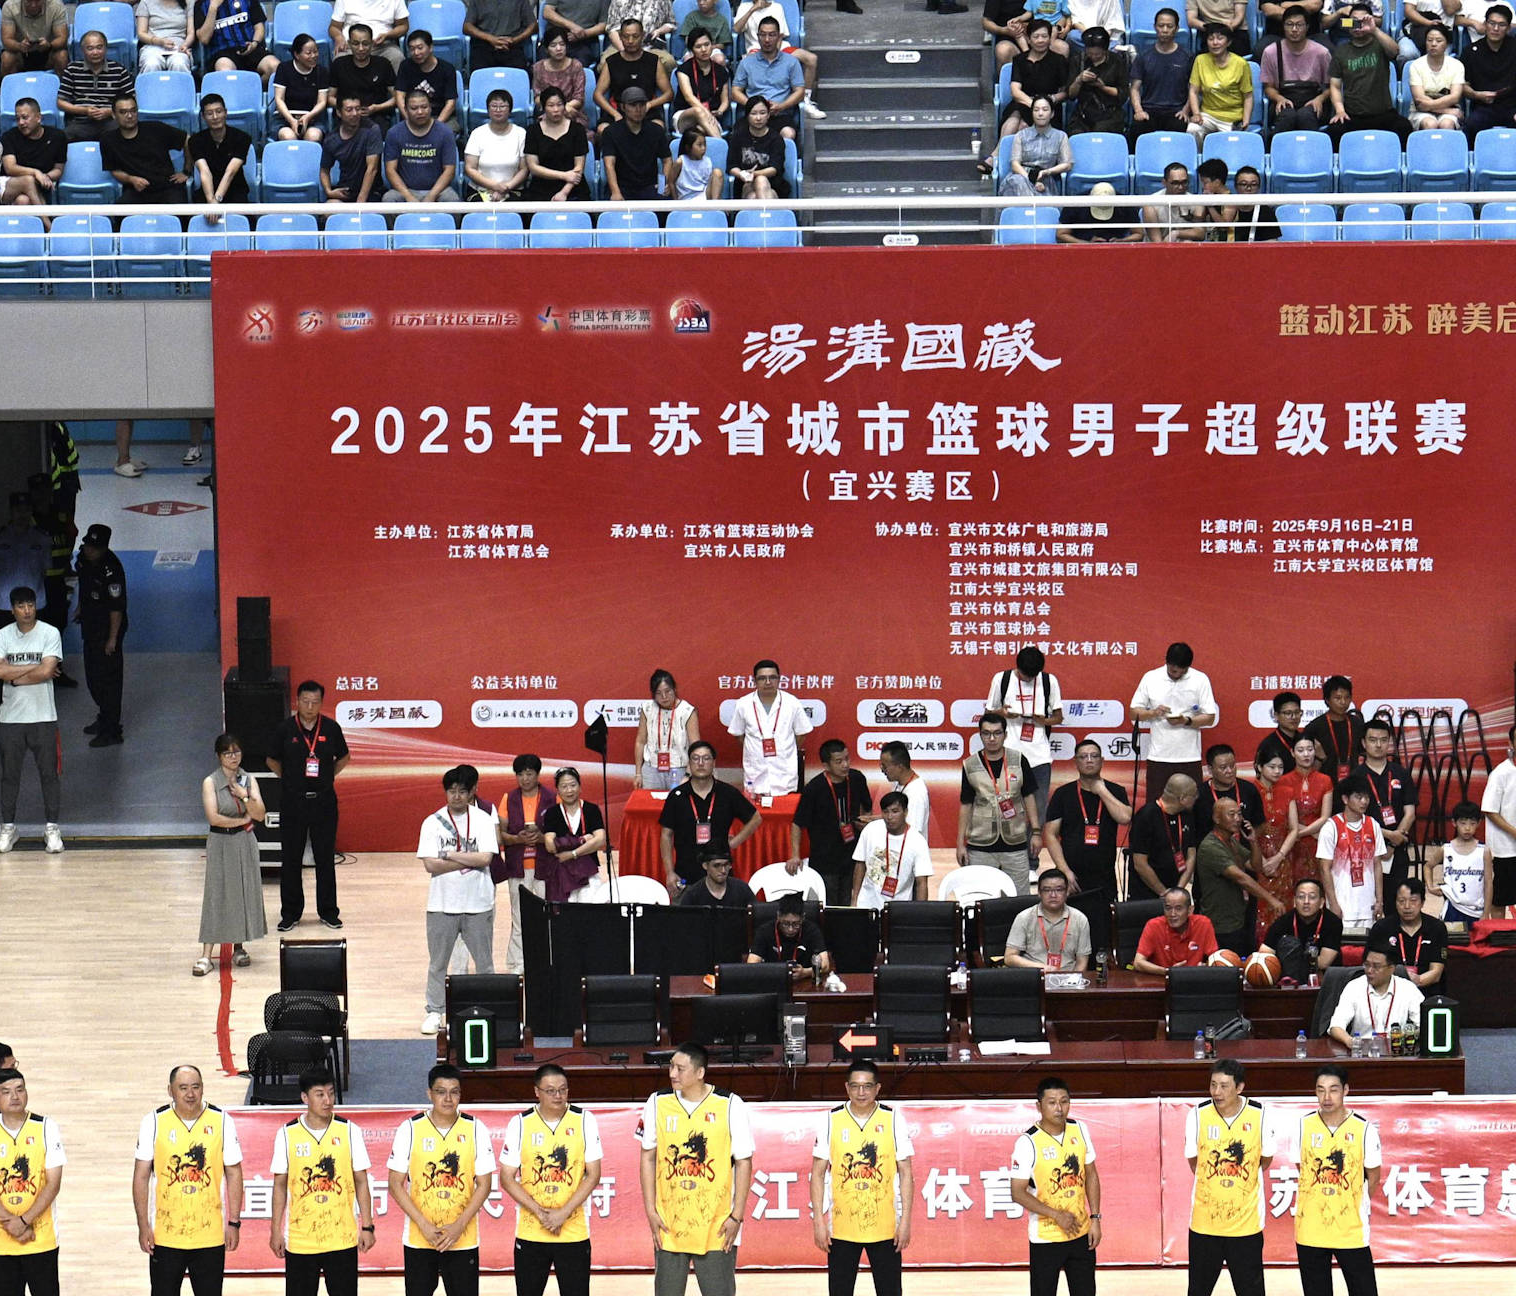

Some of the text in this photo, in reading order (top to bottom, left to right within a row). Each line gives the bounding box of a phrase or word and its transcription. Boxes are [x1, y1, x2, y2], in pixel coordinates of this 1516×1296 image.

[390, 310, 520, 328] 江苏省社区运动会
[568, 309, 652, 322] 中国体育彩票
[1279, 303, 1412, 337] 篮动江苏
[330, 400, 1468, 458] 2025年江苏省城市篮球男子超级联赛
[374, 523, 534, 540] 主办单位：江苏省体育局
[610, 523, 814, 540] 承办单位：江苏省篮球运动协会
[875, 521, 1109, 538] 协办单位：宜兴市文体广电和旅游局
[448, 543, 550, 560] 江苏省体育总会
[684, 543, 786, 560] 宜兴市人民政府
[948, 540, 1095, 558] 宜兴市和桥镇人民政府
[1200, 538, 1420, 554] 比赛地点：宜兴市体育中心体育馆
[949, 561, 1139, 578] 宜兴市城建文旅集团有限公司
[1273, 557, 1435, 574] 江南大学宜兴校区体育馆
[949, 580, 1066, 598] 江南大学宜兴校区
[949, 600, 1052, 617] 宜兴市体育总会
[949, 620, 1052, 637] 宜兴市篮球协会
[335, 676, 379, 691] 总冠名
[471, 675, 559, 690] 公益支持单位
[718, 676, 835, 690] 官方战合作伙伴
[855, 675, 943, 690] 官方赞助单位
[1249, 675, 1352, 690] 直播数据供
[865, 741, 889, 752] PIC
[896, 742, 960, 752] 国人民保险
[1460, 882, 1466, 894] 3
[1208, 1126, 1219, 1140] 10
[1311, 1133, 1324, 1148] 12
